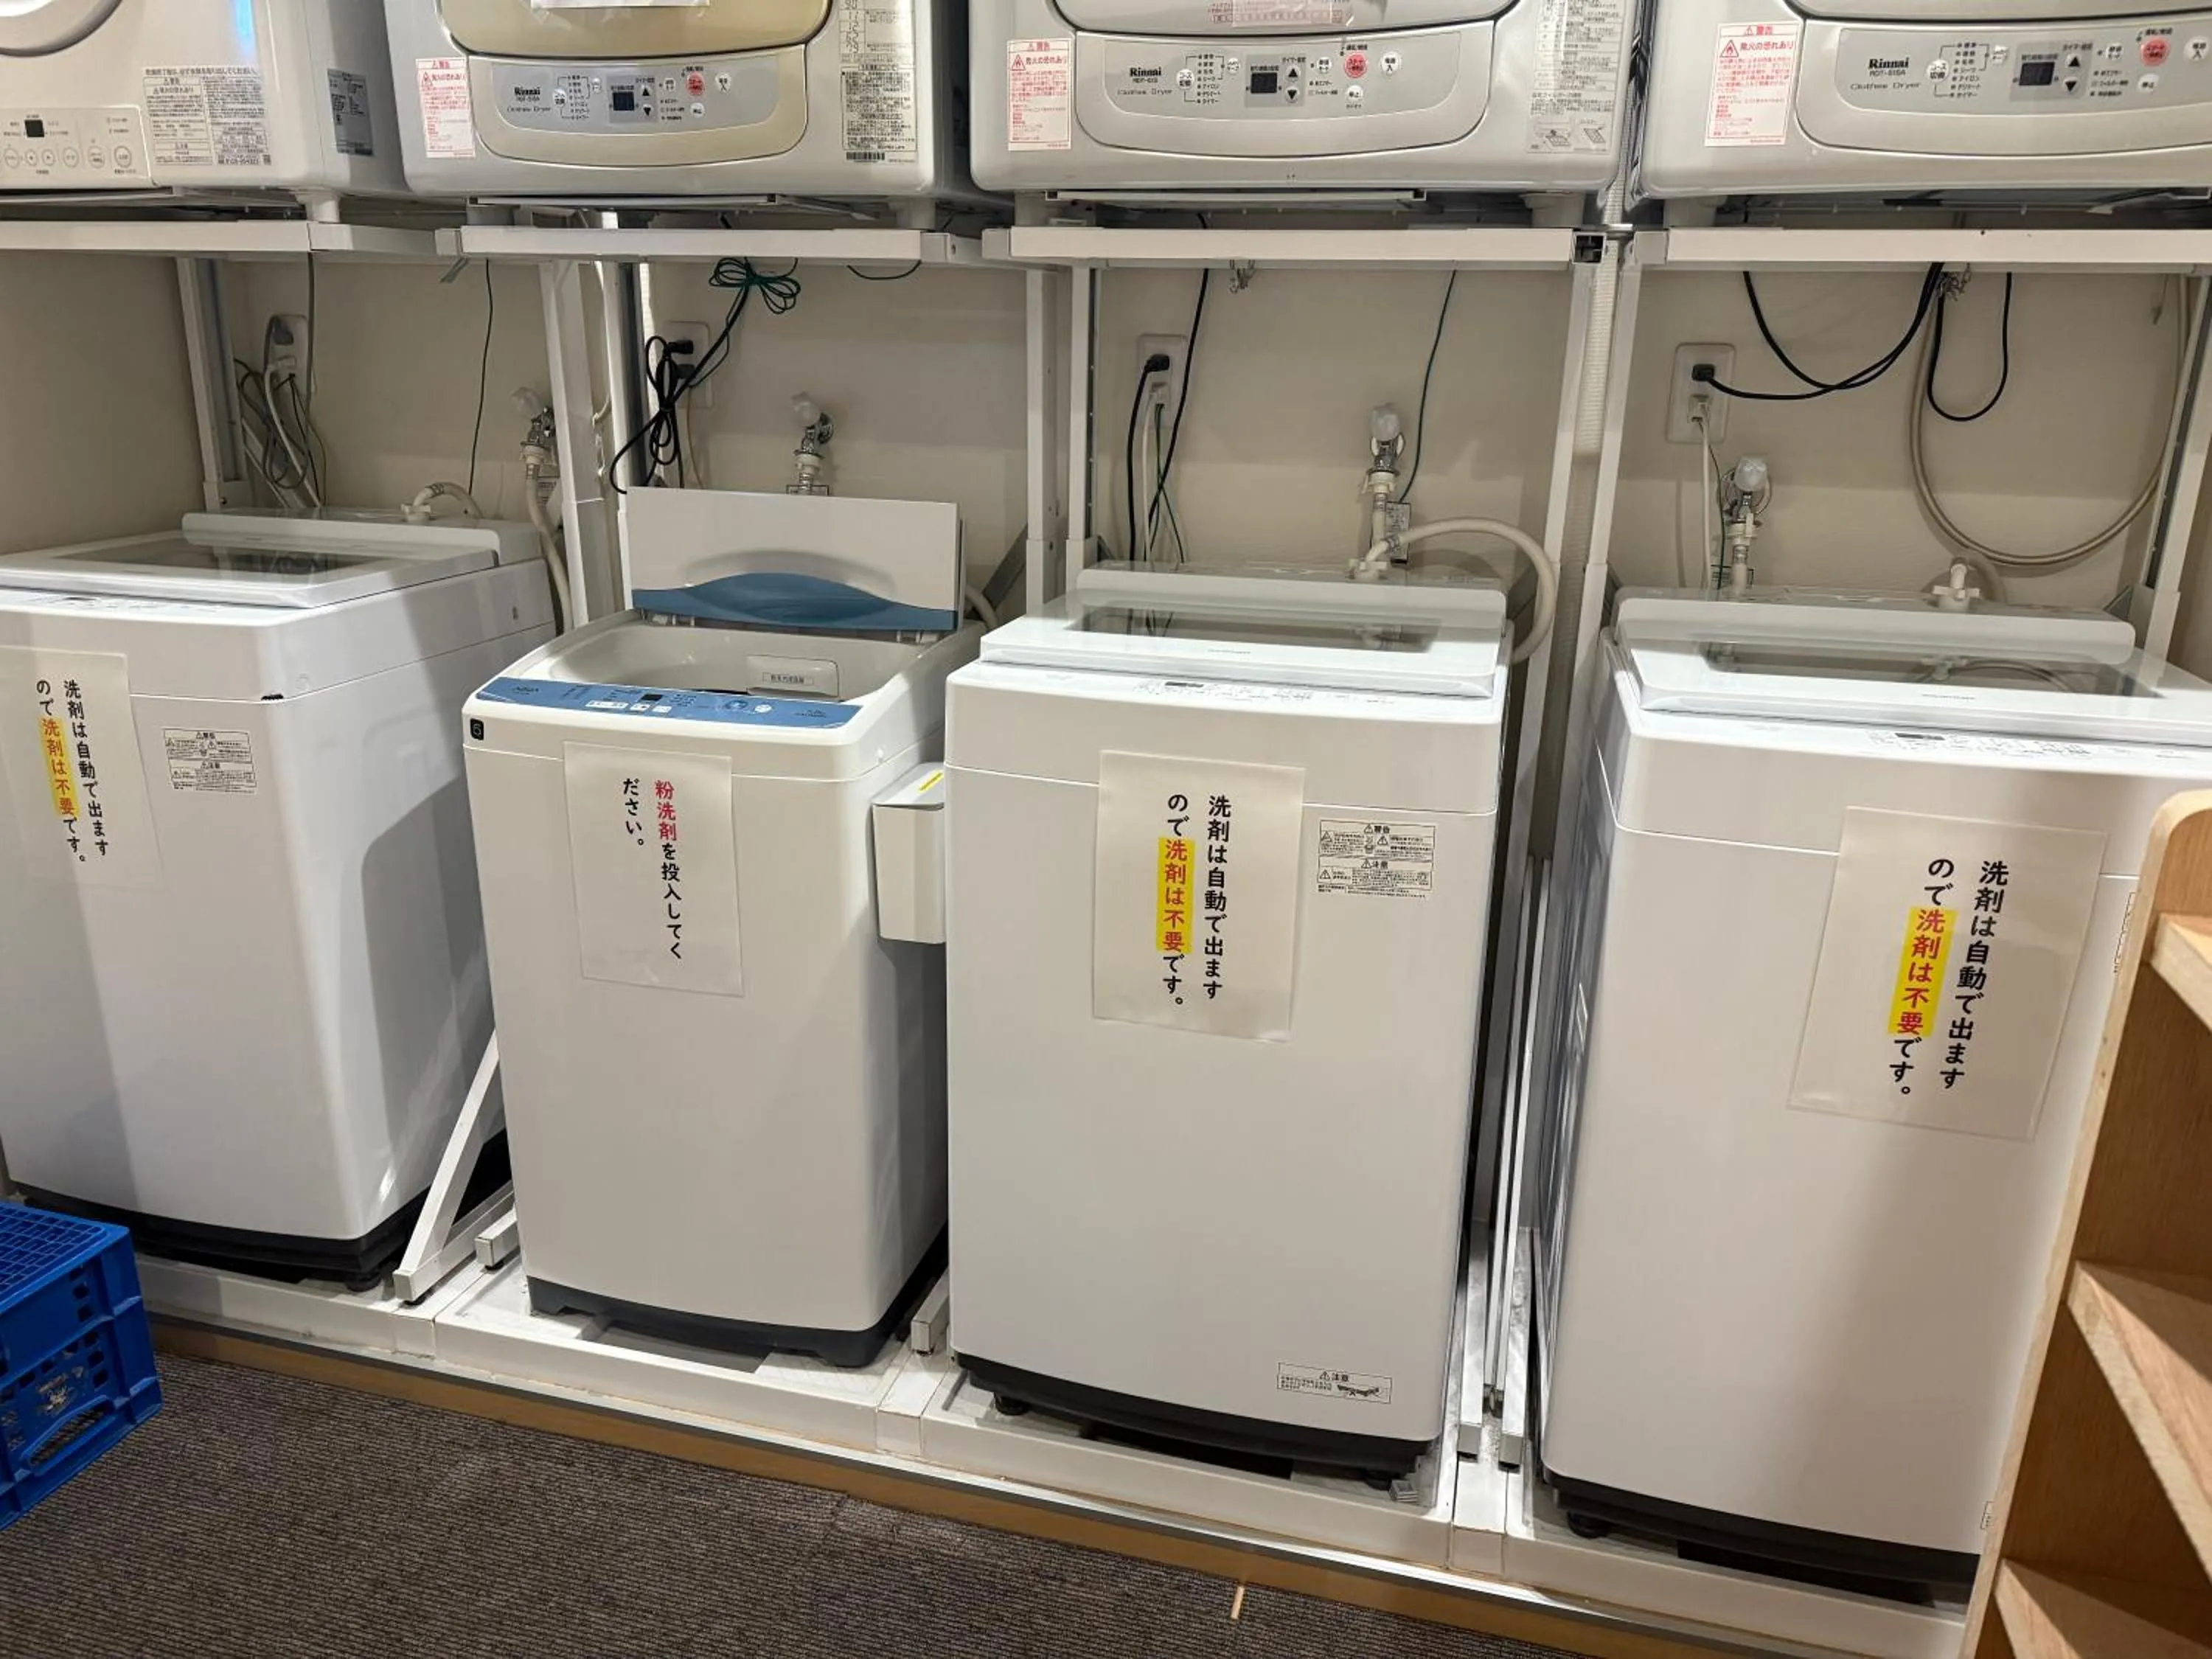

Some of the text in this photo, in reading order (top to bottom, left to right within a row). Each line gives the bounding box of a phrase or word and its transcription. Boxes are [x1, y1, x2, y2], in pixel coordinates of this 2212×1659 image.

[1130, 67, 1161, 77] Rinnai
[1868, 57, 1909, 69] Rinnai
[37, 679, 86, 862] ので洗剤は不要です。
[63, 679, 108, 856] 洗剤は自動で出ます
[623, 778, 644, 846] ださい。
[655, 779, 682, 959] 粉洗剤を投入してく
[1162, 793, 1189, 1006] ので洗剤は不要です。
[1203, 795, 1231, 1000] 洗剤は自動で出ます
[1889, 858, 1955, 1096] ので洗剤は不要です。
[1940, 860, 2010, 1090] 洗剤は自動で出ます
